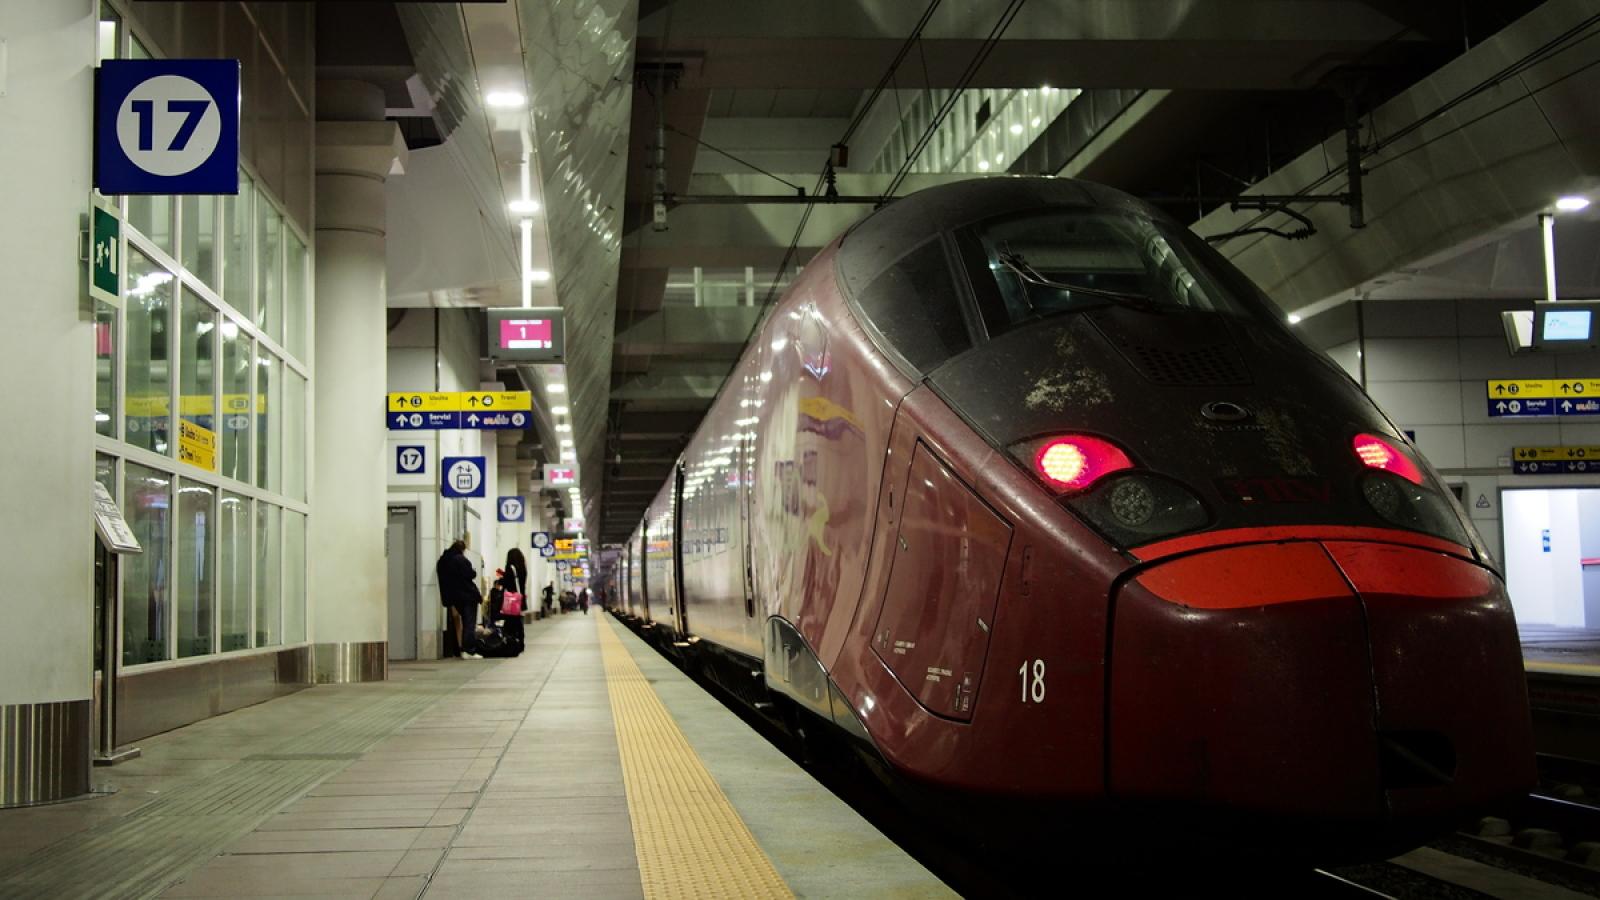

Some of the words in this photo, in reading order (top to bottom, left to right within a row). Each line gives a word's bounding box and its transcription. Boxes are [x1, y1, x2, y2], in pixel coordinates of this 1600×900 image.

[131, 100, 211, 151] 17
[520, 326, 526, 339] 1
[403, 454, 419, 465] 17
[504, 503, 519, 515] 17
[1019, 659, 1045, 703] 18
